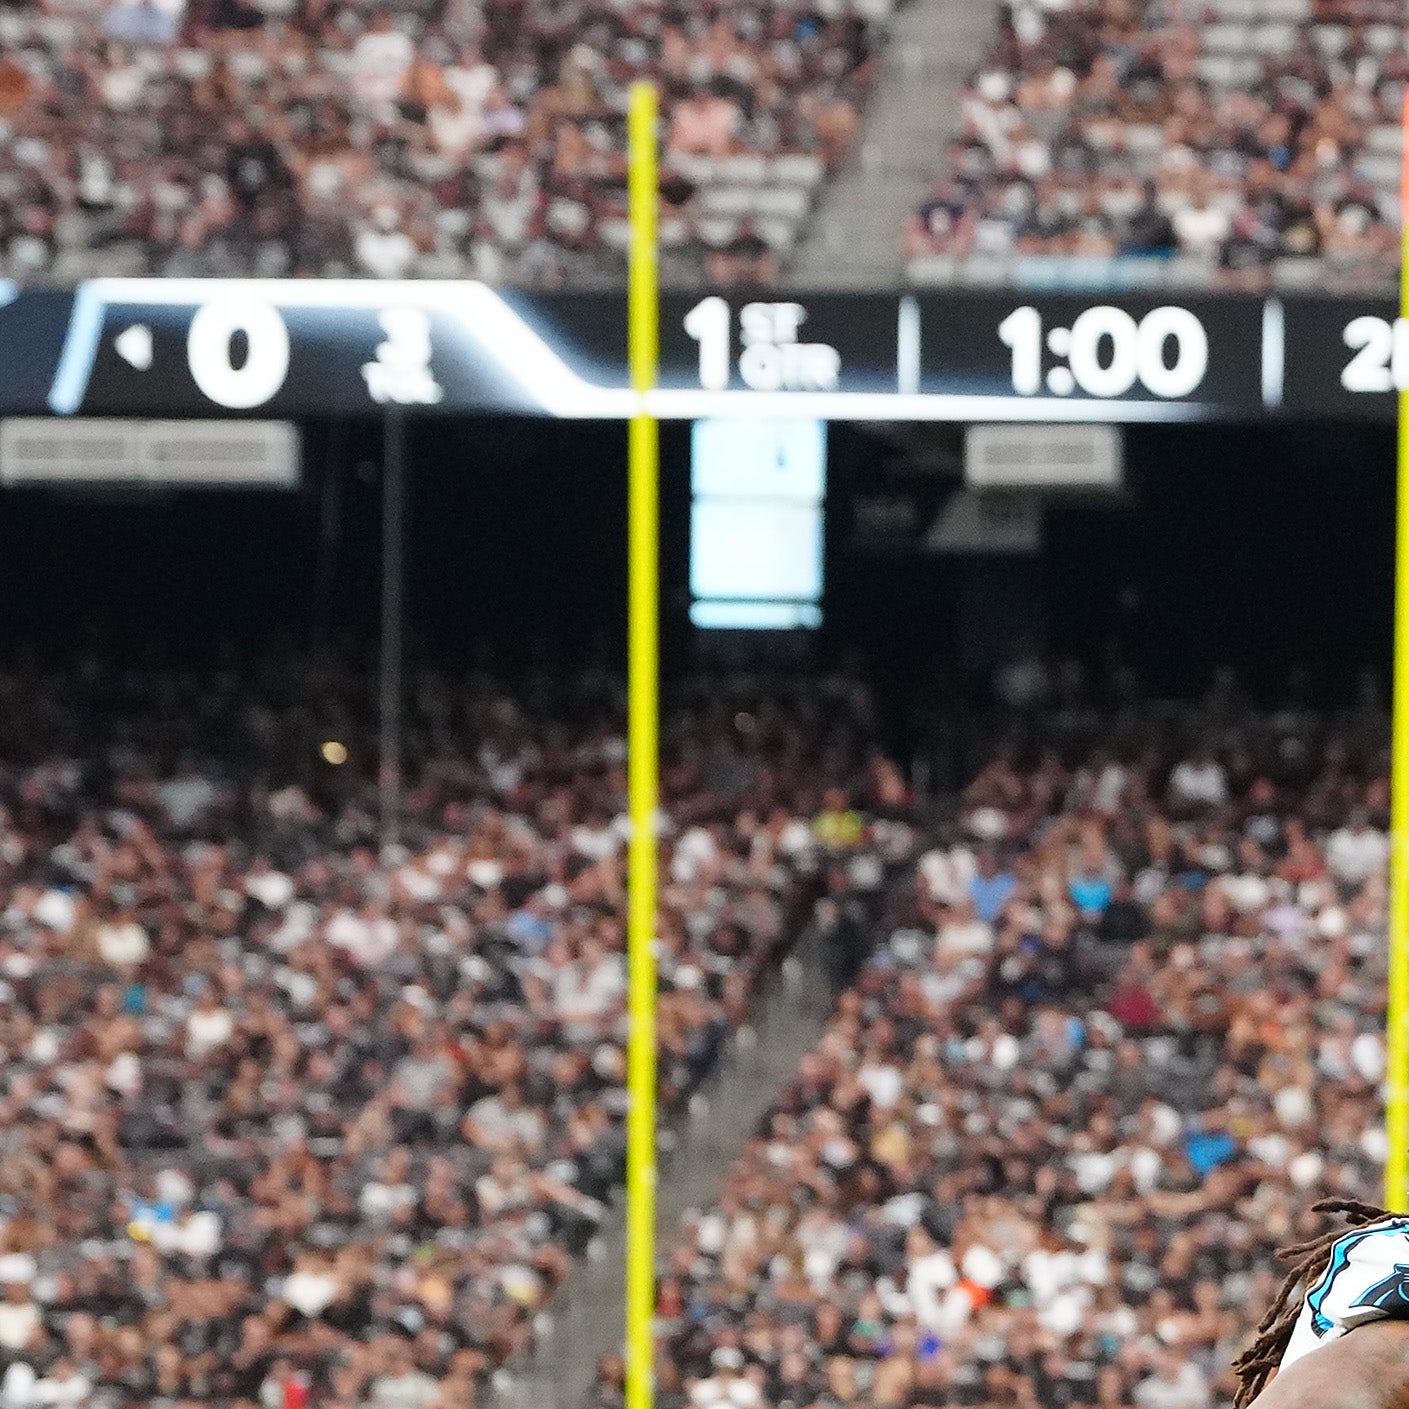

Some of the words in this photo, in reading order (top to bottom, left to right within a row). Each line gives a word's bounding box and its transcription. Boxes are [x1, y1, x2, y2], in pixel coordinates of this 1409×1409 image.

[188, 297, 290, 408] 0
[684, 297, 730, 391] 1
[1000, 306, 1208, 397] 1:00
